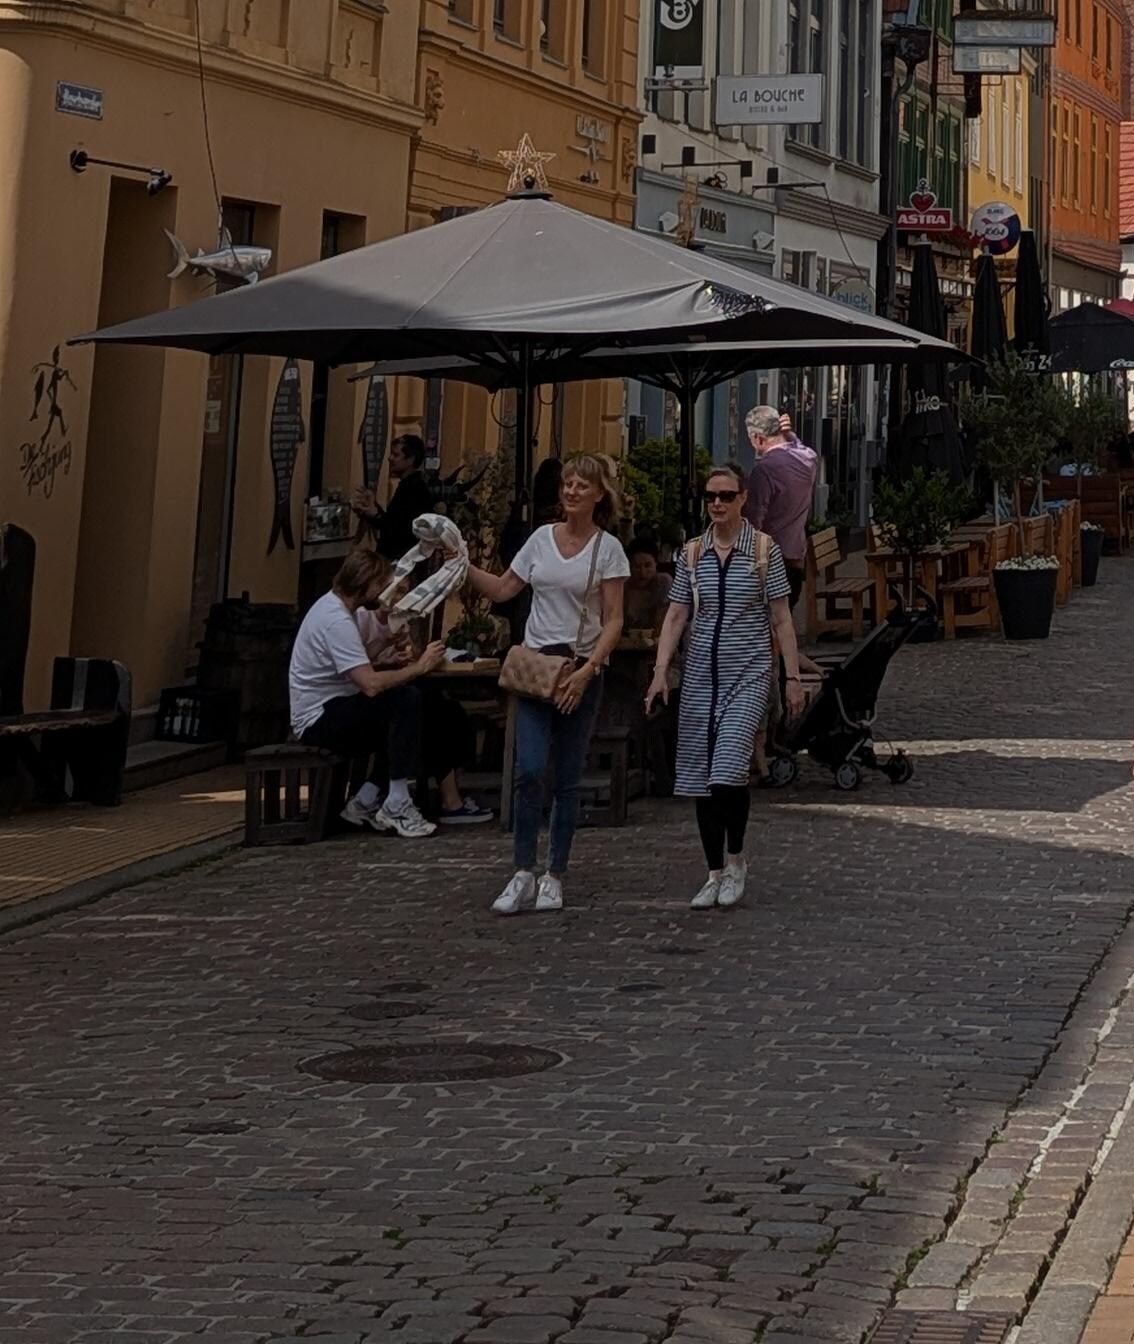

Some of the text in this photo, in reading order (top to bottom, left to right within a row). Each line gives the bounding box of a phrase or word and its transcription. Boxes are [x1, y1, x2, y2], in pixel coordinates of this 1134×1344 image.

[732, 88, 805, 103] LA BOUCHE
[897, 213, 947, 225] ASTRA
